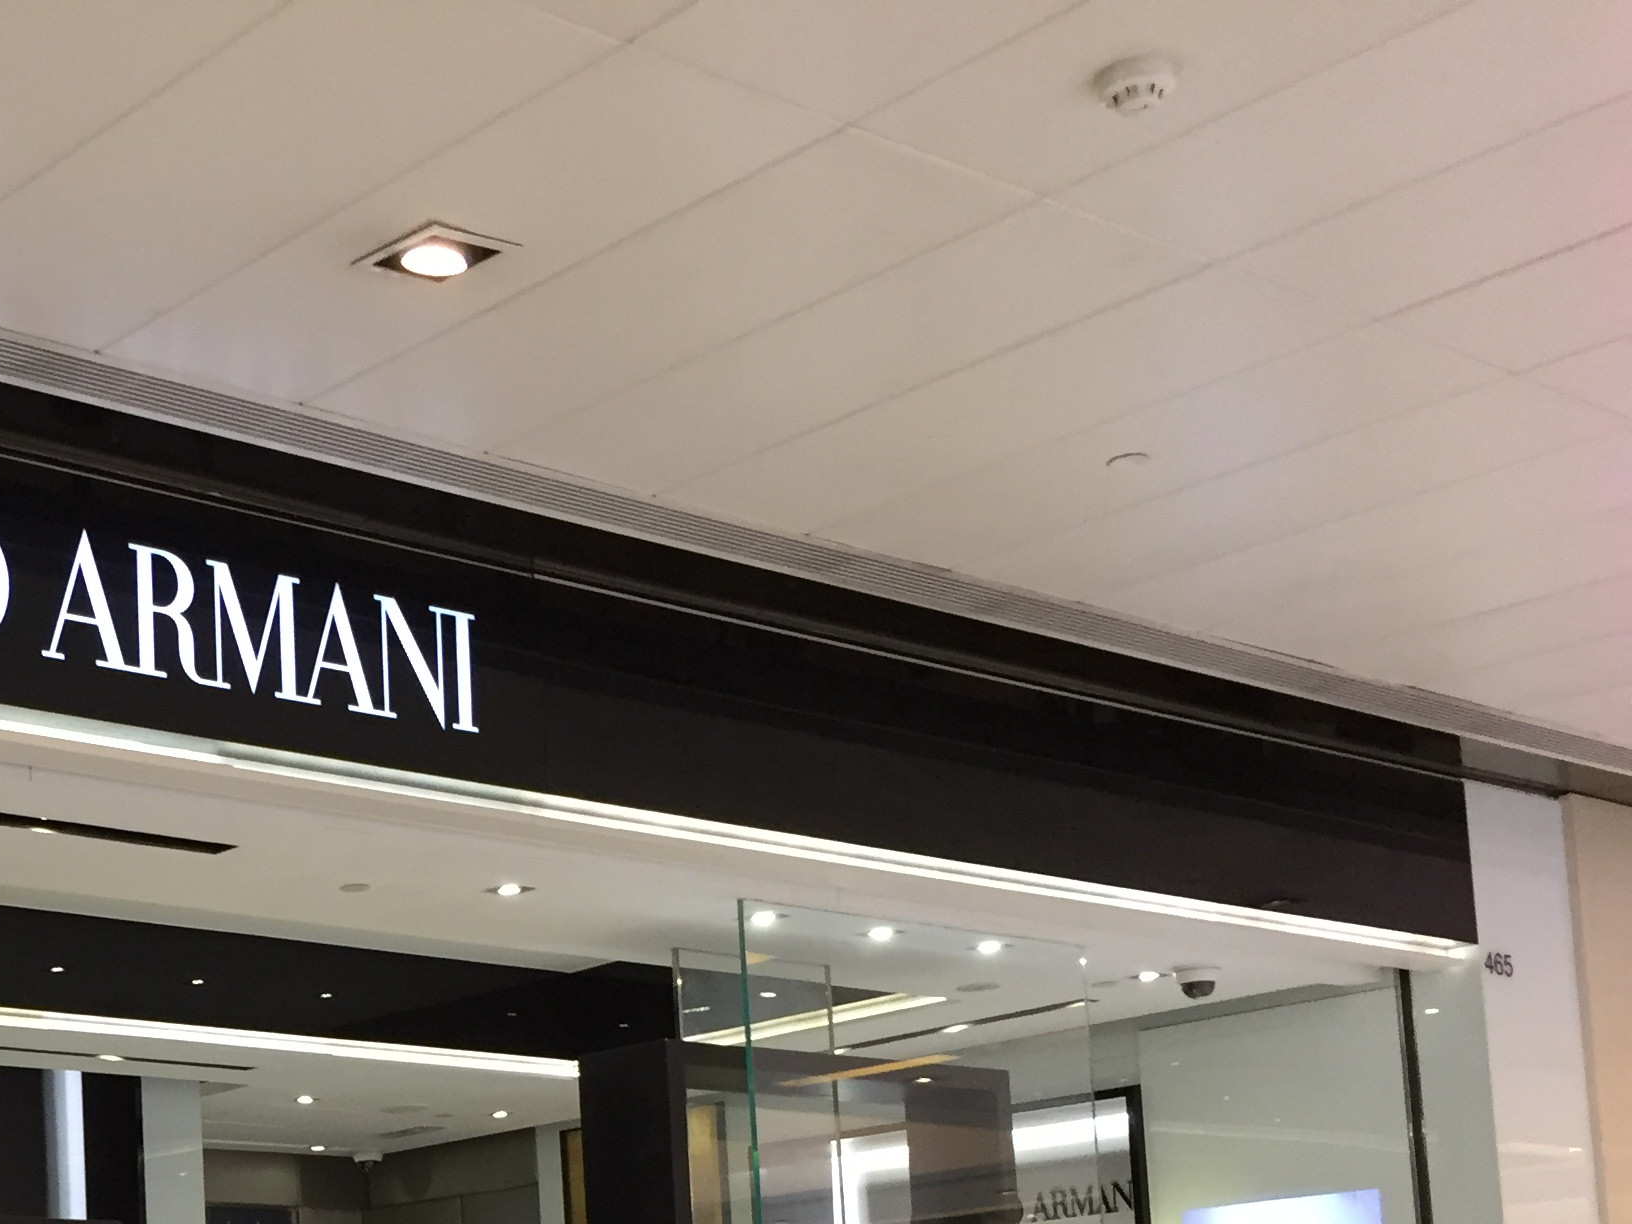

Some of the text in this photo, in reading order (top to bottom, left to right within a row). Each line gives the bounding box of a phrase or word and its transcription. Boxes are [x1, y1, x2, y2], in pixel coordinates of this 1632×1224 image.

[41, 528, 480, 734] ARMANI
[1484, 951, 1514, 978] 465
[1032, 1180, 1135, 1222] ARMAN
